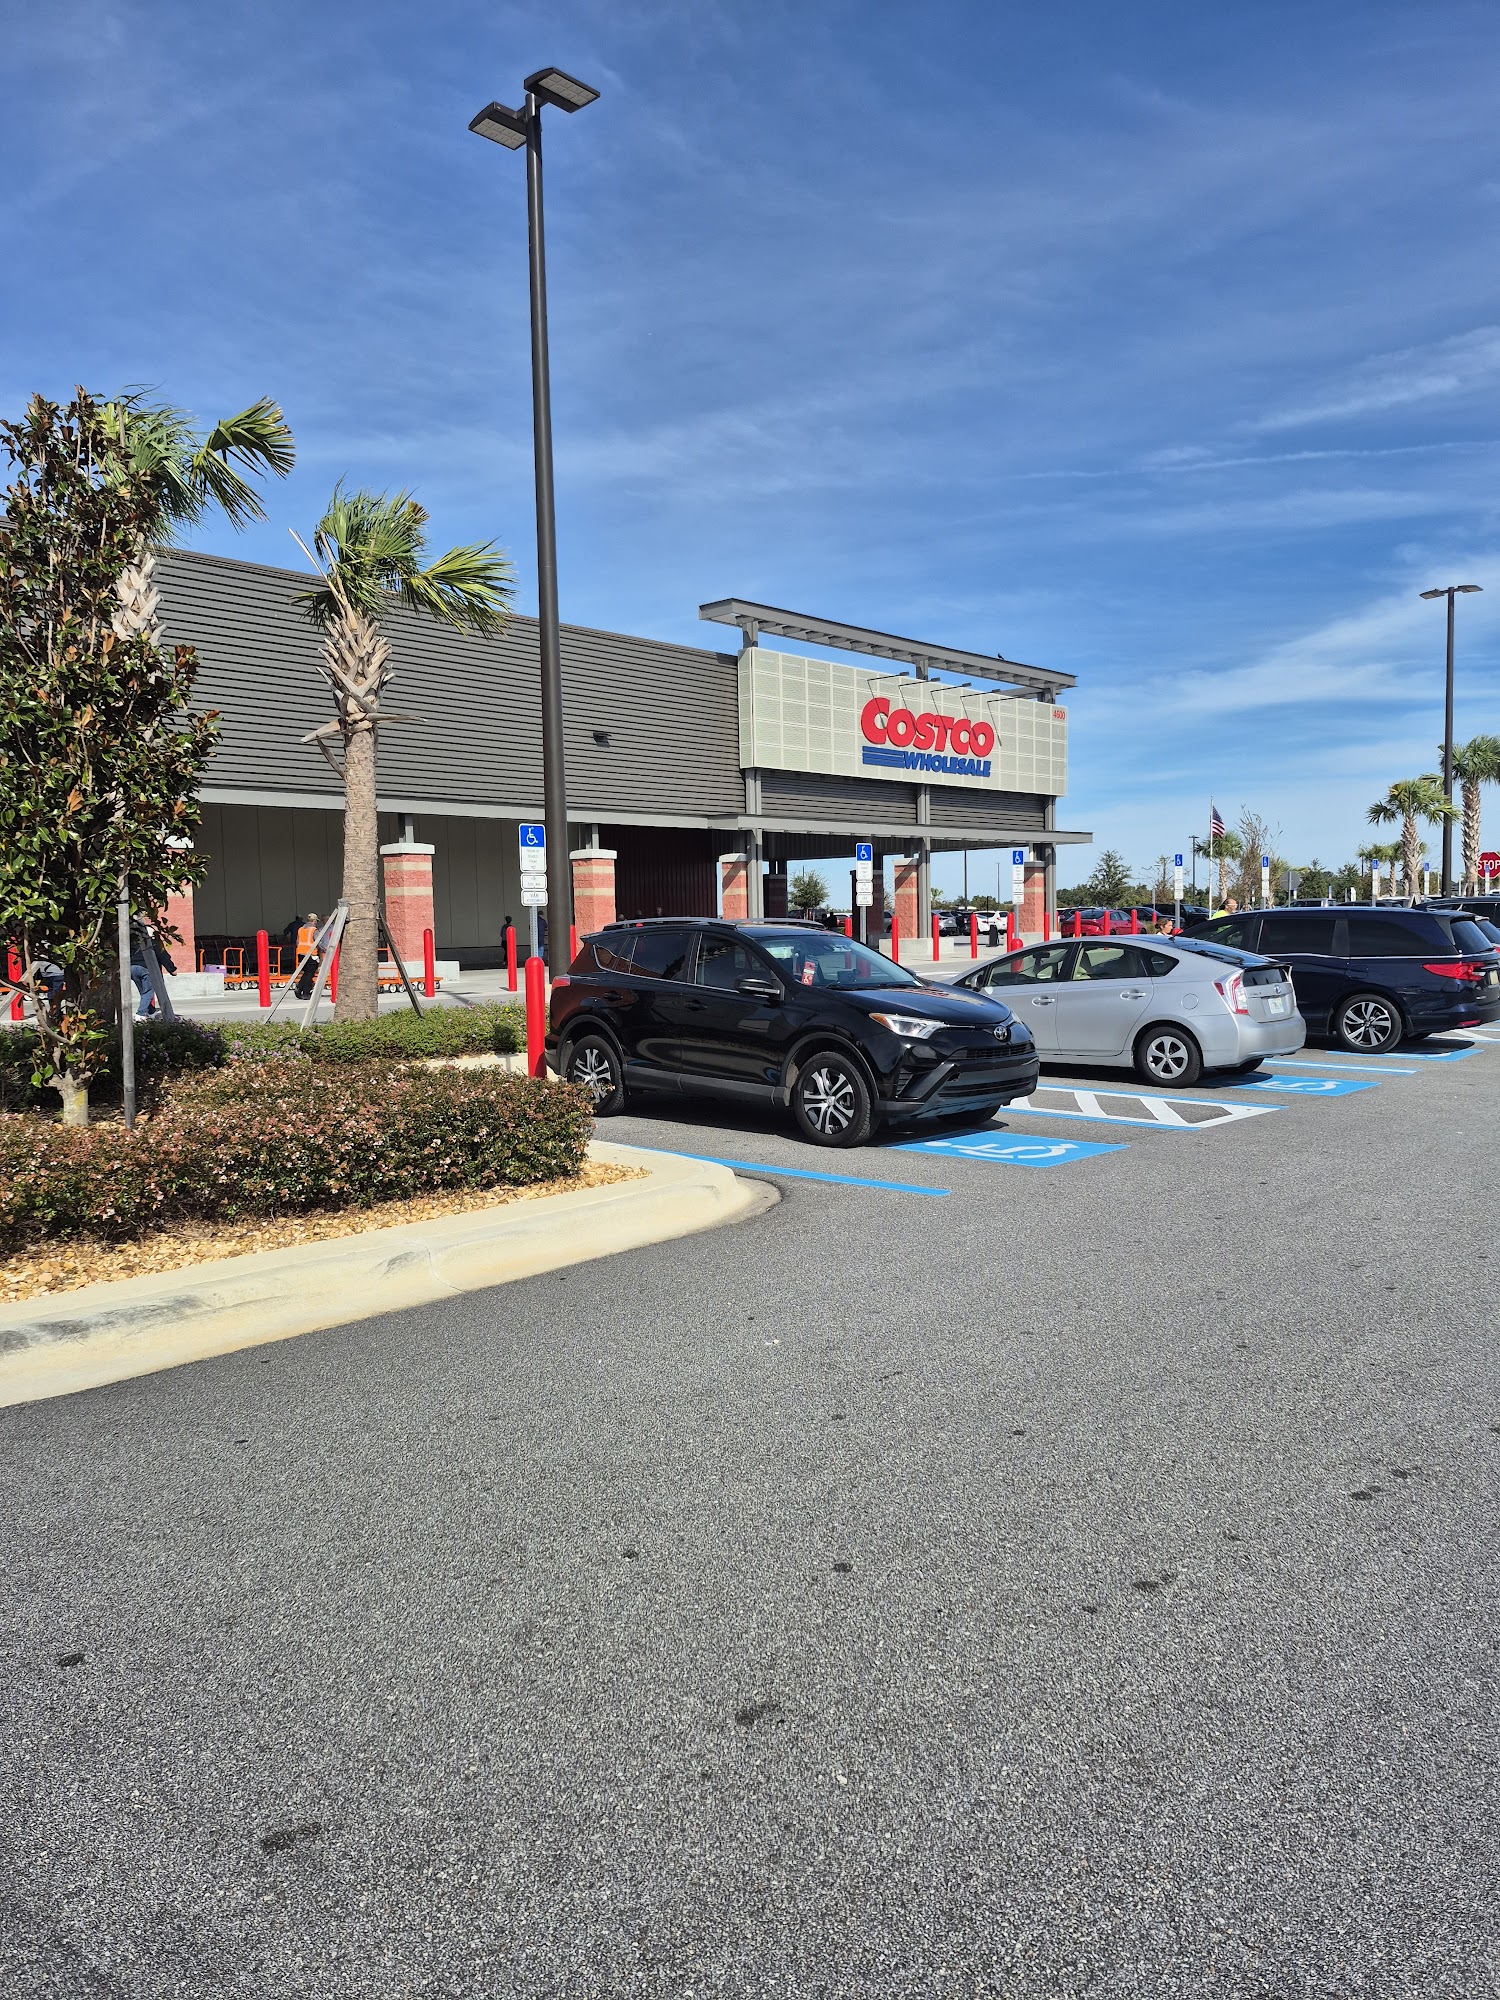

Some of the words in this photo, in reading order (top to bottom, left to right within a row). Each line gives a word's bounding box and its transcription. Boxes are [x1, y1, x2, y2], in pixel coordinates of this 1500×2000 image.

[861, 697, 995, 757] COSTCO
[903, 750, 992, 777] WHOLESALE
[1477, 859, 1500, 870] STOP
